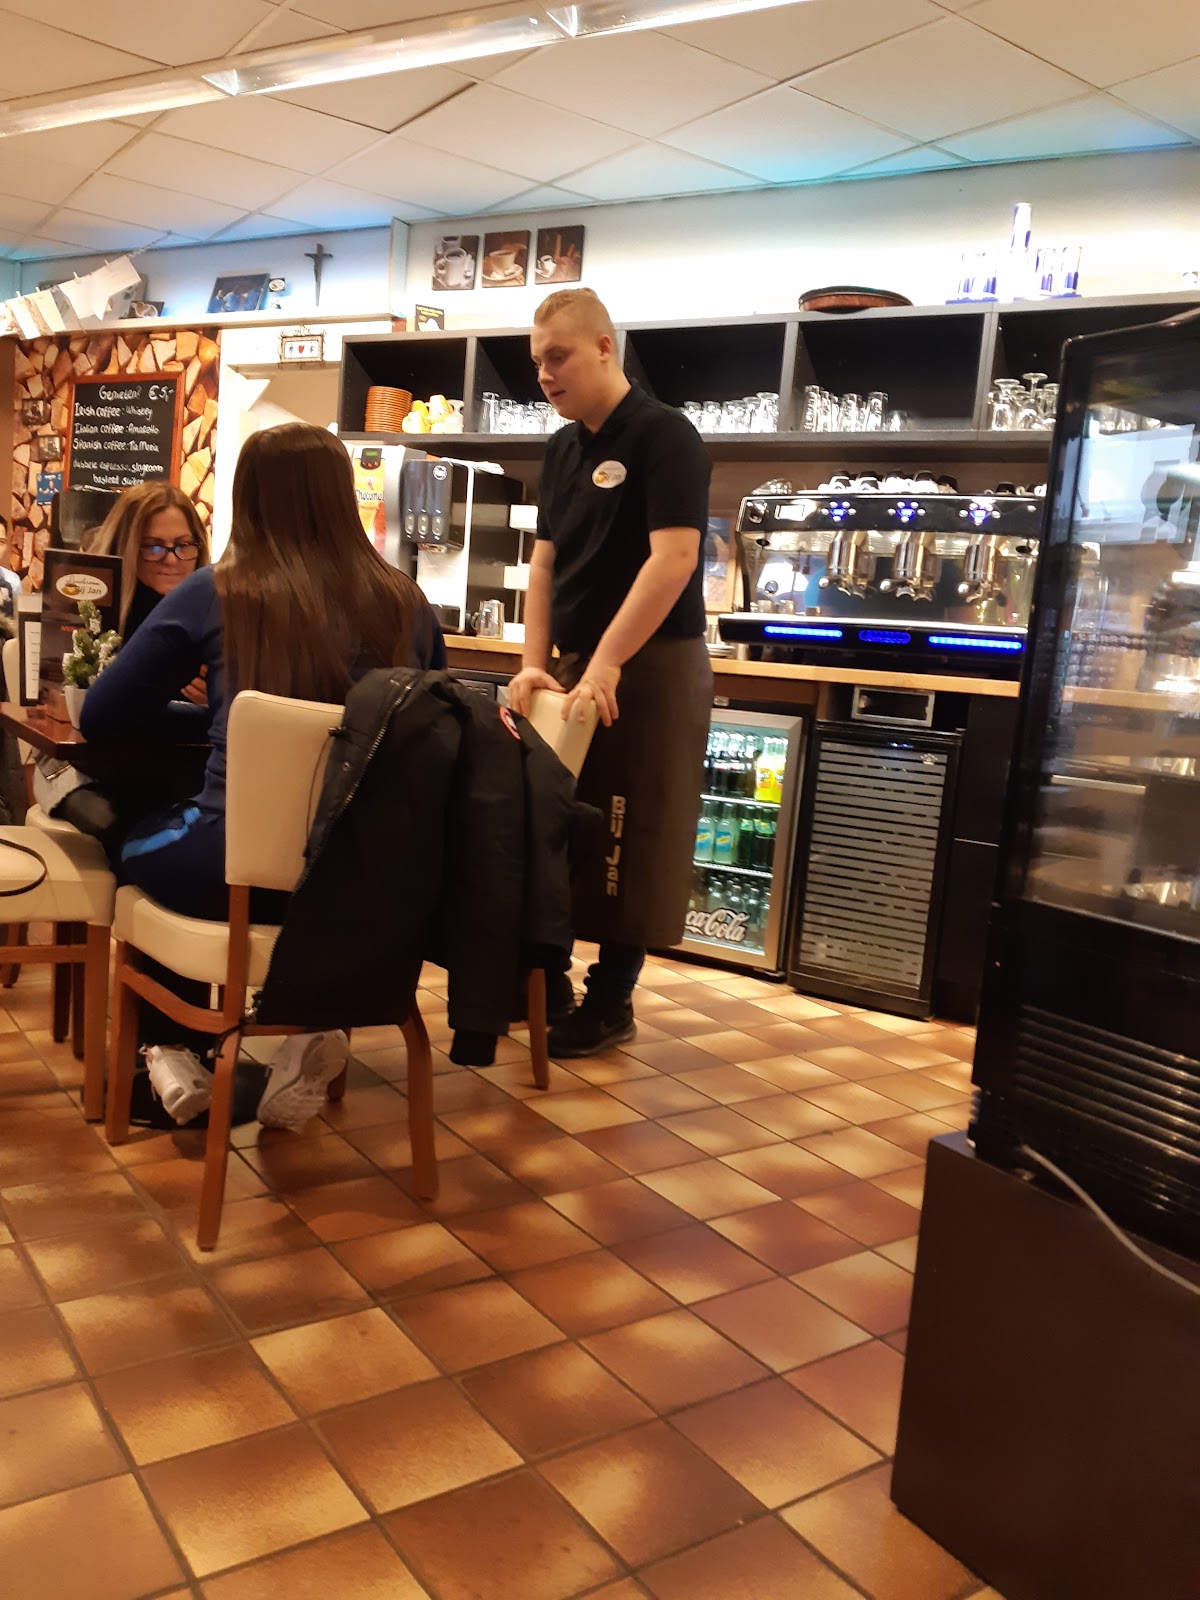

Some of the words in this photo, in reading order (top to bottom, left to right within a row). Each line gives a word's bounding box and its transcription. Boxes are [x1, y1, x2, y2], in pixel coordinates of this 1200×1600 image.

[74, 402, 96, 417] Irish
[74, 422, 99, 435] Italian
[72, 437, 102, 451] Spanish
